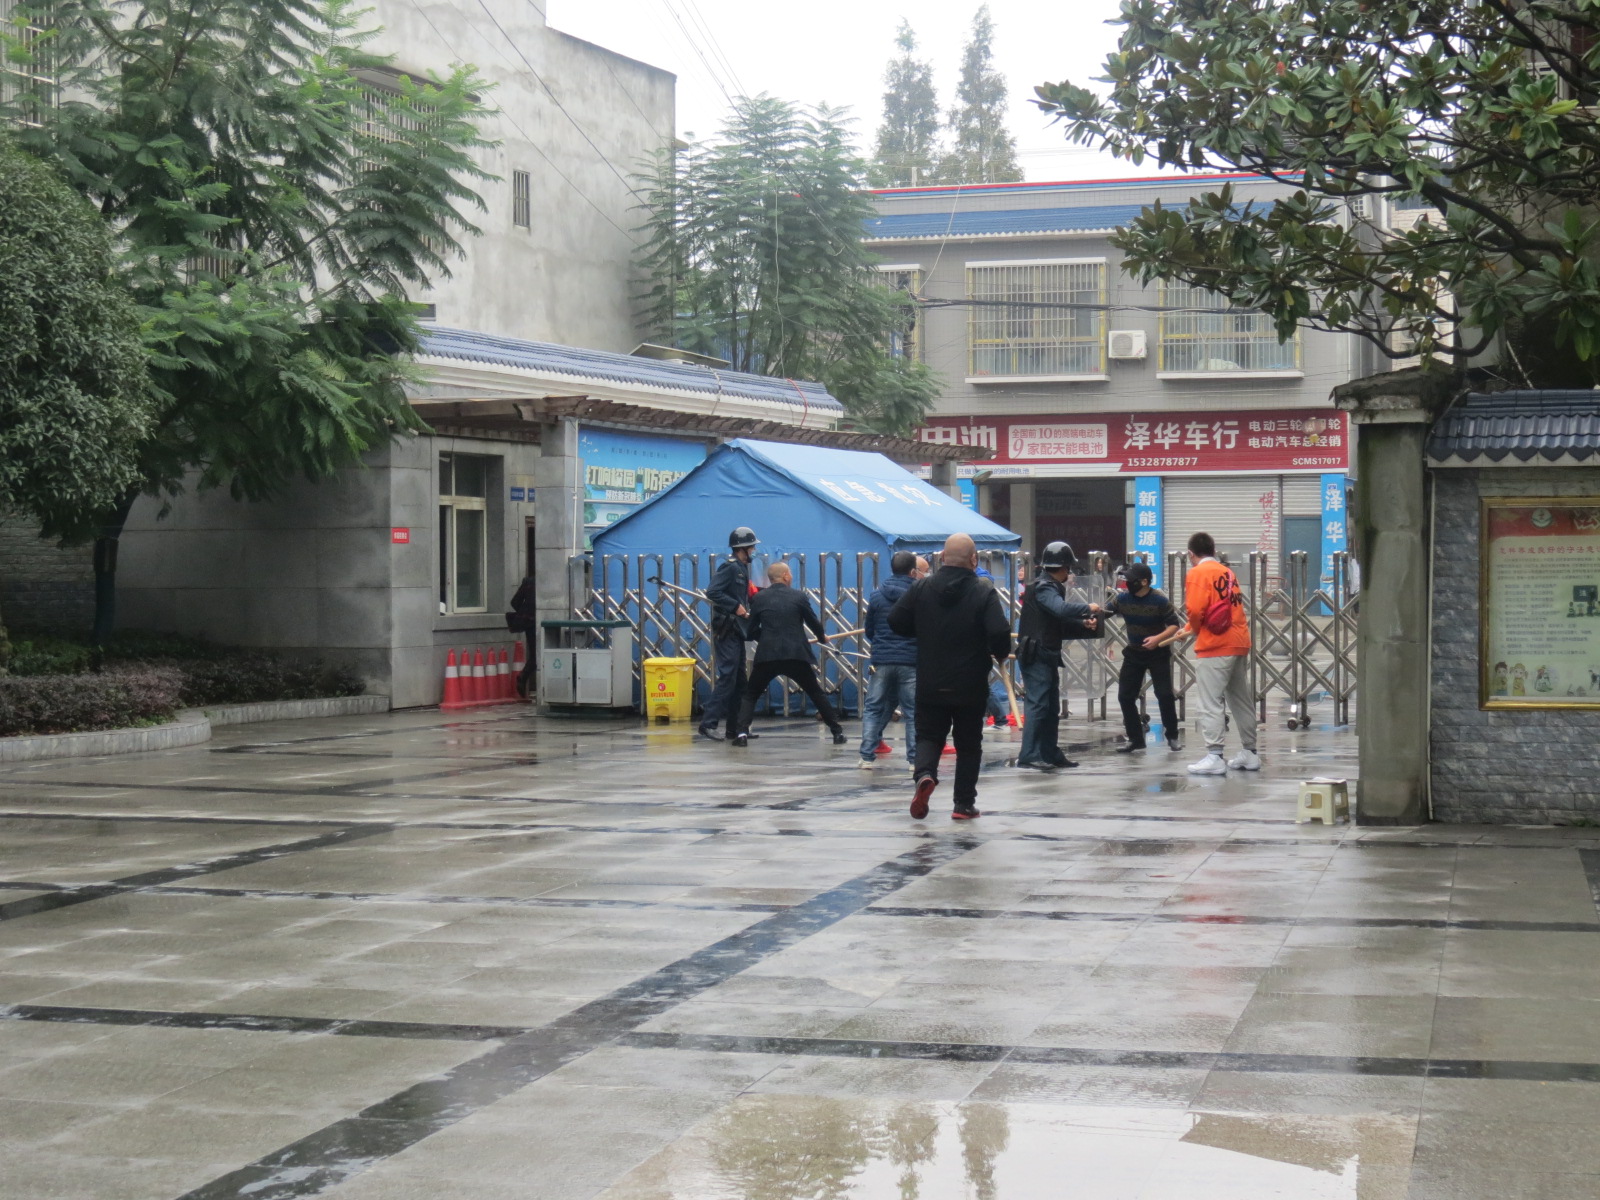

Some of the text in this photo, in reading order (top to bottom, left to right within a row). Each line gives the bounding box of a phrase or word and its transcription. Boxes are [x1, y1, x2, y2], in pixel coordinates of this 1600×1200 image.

[1012, 427, 1104, 440] 全国前10的高端电动车
[1123, 421, 1240, 450] 泽华车行
[1248, 435, 1341, 448] 电动汽车总经销
[1127, 457, 1198, 467] 15328787877
[1292, 457, 1341, 465] SCMS17017
[957, 467, 1030, 476] 只做的耐用电池
